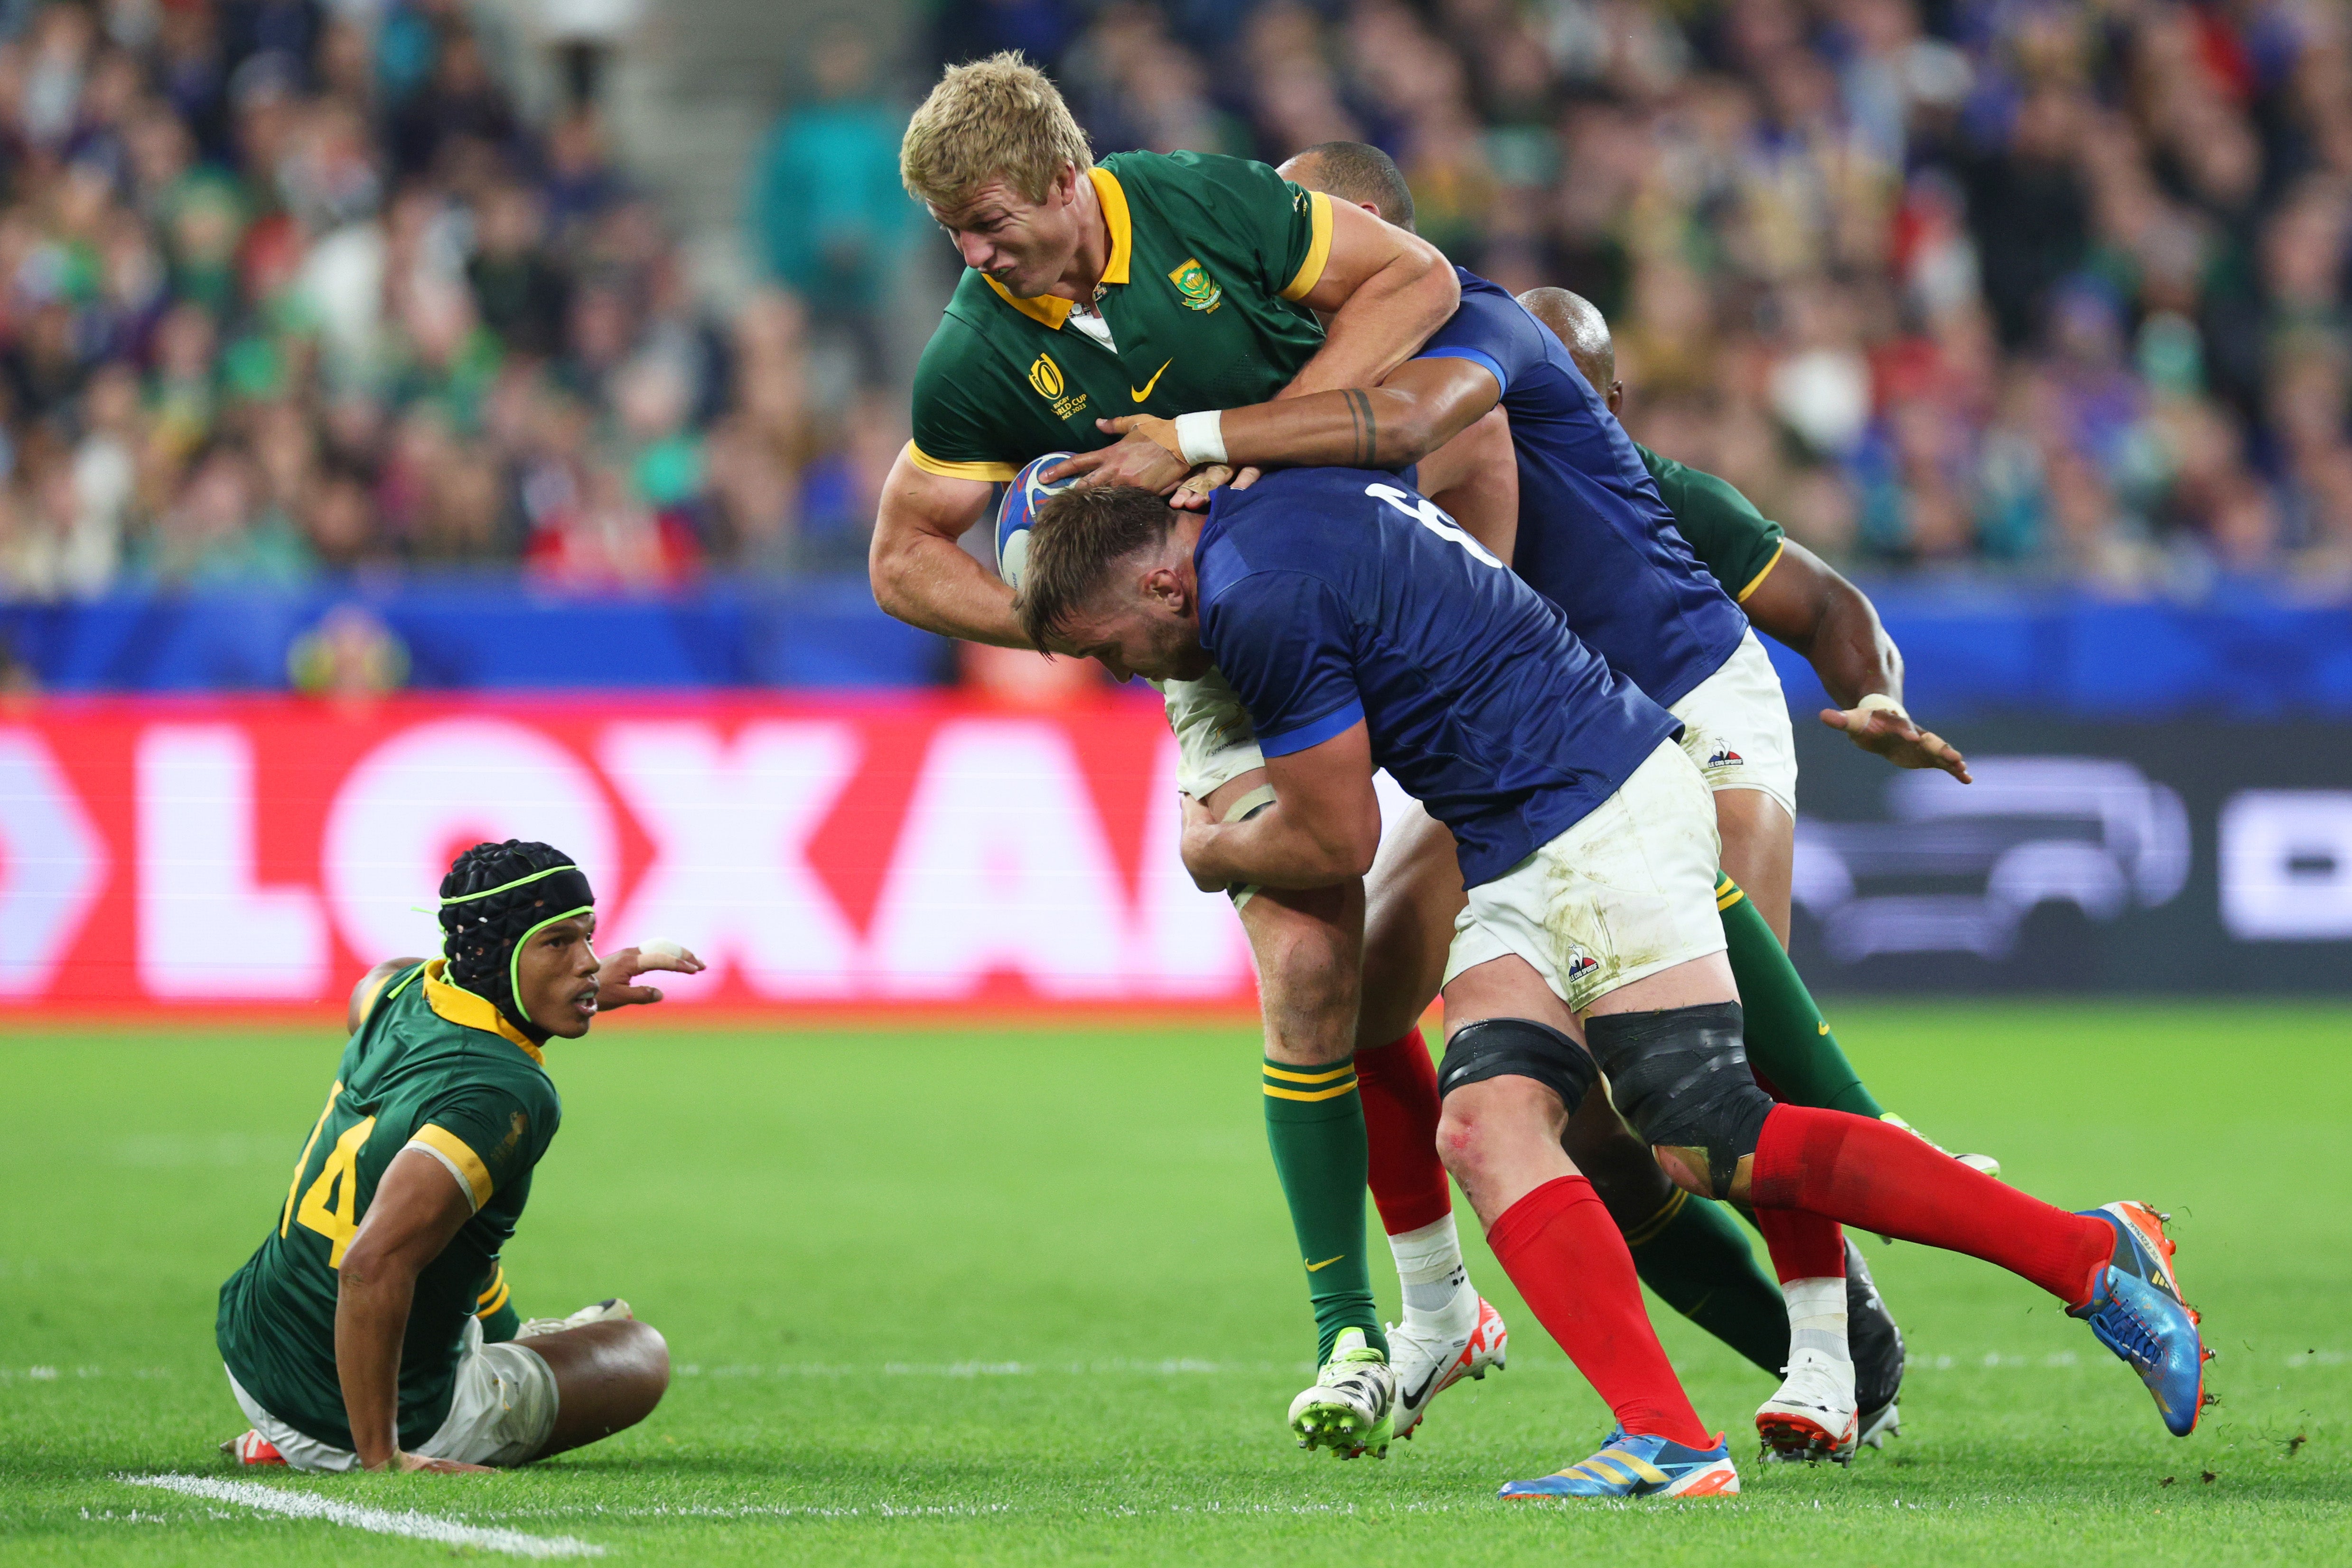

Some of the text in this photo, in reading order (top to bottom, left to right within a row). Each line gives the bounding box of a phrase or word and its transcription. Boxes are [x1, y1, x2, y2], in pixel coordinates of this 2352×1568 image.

[1053, 395, 1069, 409] RUGBY
[1072, 393, 1086, 406] CUP
[1072, 403, 1087, 414] 2023
[1364, 483, 1503, 569] 6
[1574, 971, 1583, 979] COQ
[1581, 963, 1597, 975] SPORTIF
[280, 1079, 376, 1270] 14
